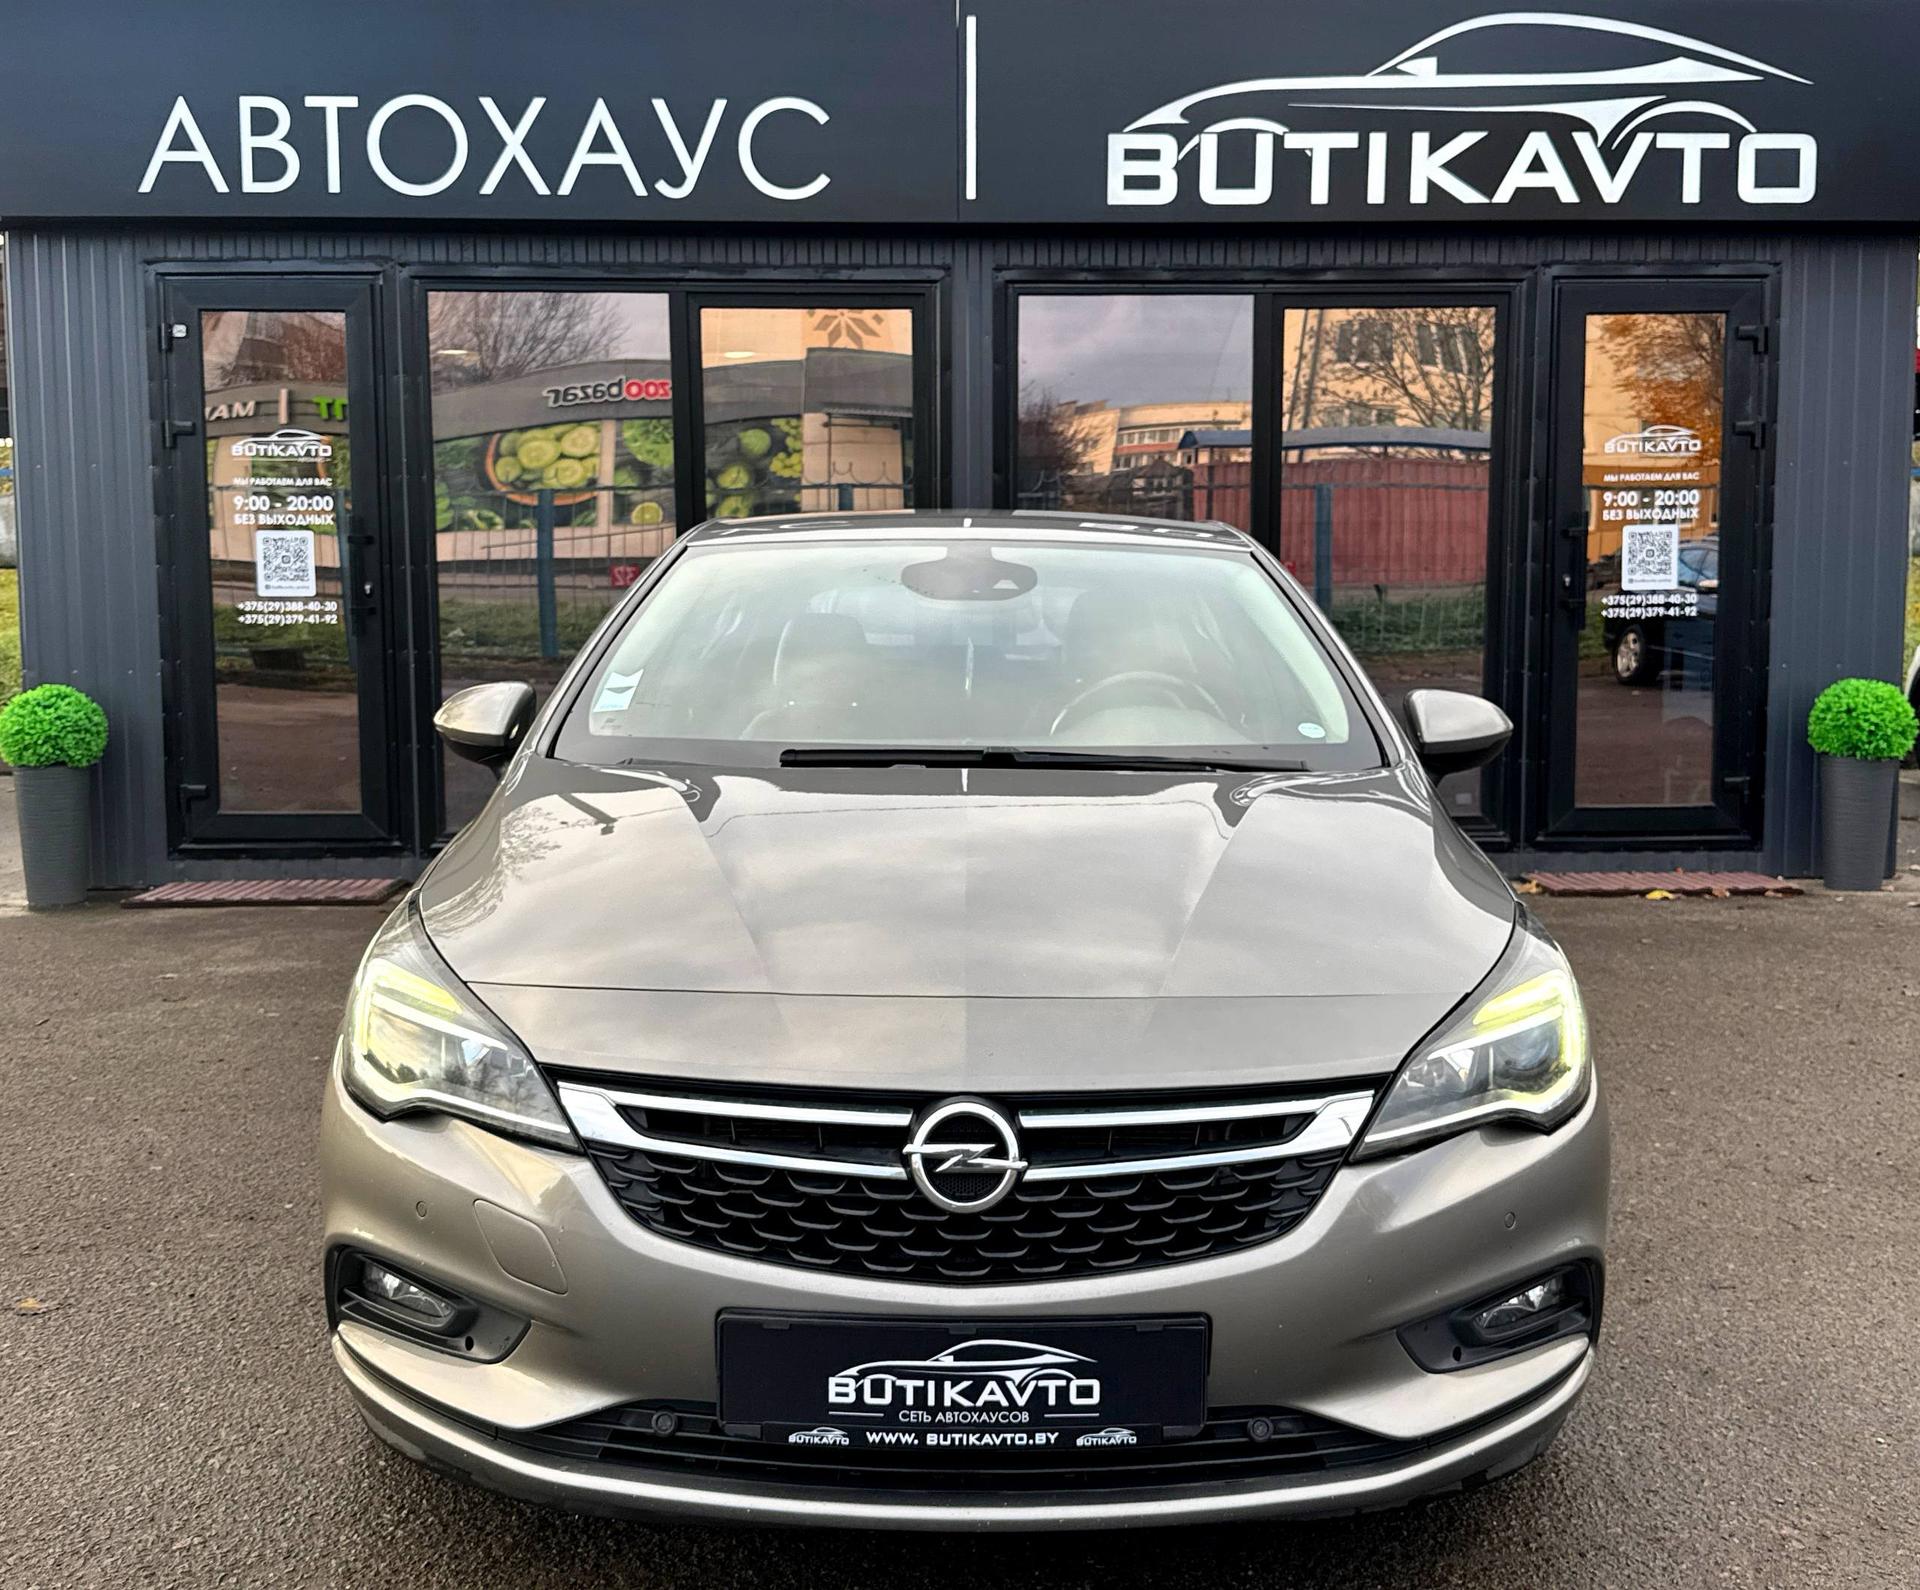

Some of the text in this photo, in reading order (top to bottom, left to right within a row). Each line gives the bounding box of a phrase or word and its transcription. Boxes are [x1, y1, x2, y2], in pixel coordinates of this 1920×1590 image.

[138, 94, 832, 201] АВТОХАУС
[1106, 131, 1819, 206] BUTIKAVTO
[231, 444, 332, 457] BUTIKAVTO
[1604, 439, 1702, 453] BUTIKAVTO
[250, 477, 294, 486] РАБОТАЕМ
[295, 477, 313, 486] ДЛЯ
[314, 477, 333, 487] ВАС
[1619, 473, 1662, 481] РАБОТАЕМ
[1663, 472, 1681, 481] ДЛЯ
[1682, 472, 1700, 480] ВАС
[233, 495, 270, 511] 9:00
[286, 495, 334, 511] 20:00
[1603, 491, 1638, 507] 9:00
[1654, 489, 1700, 506] 20:00
[234, 513, 334, 525] БЕЗ ВЫХОДНЫХ
[1603, 508, 1699, 521] БЕЗ ВЫХОДНЫХ
[1601, 606, 1697, 619] +375(29)379-41-92
[237, 614, 338, 627] +375(29)379-41-92
[828, 1376, 1101, 1407] BUTIKAVTO
[899, 1409, 1030, 1424] СЕТЬ АВТОХАУСОВ
[788, 1434, 850, 1446] BUTIKAVTO
[865, 1431, 1059, 1446] WWW. BUTIKAVTO.BY
[1076, 1434, 1138, 1446] BUTIKAVTO
